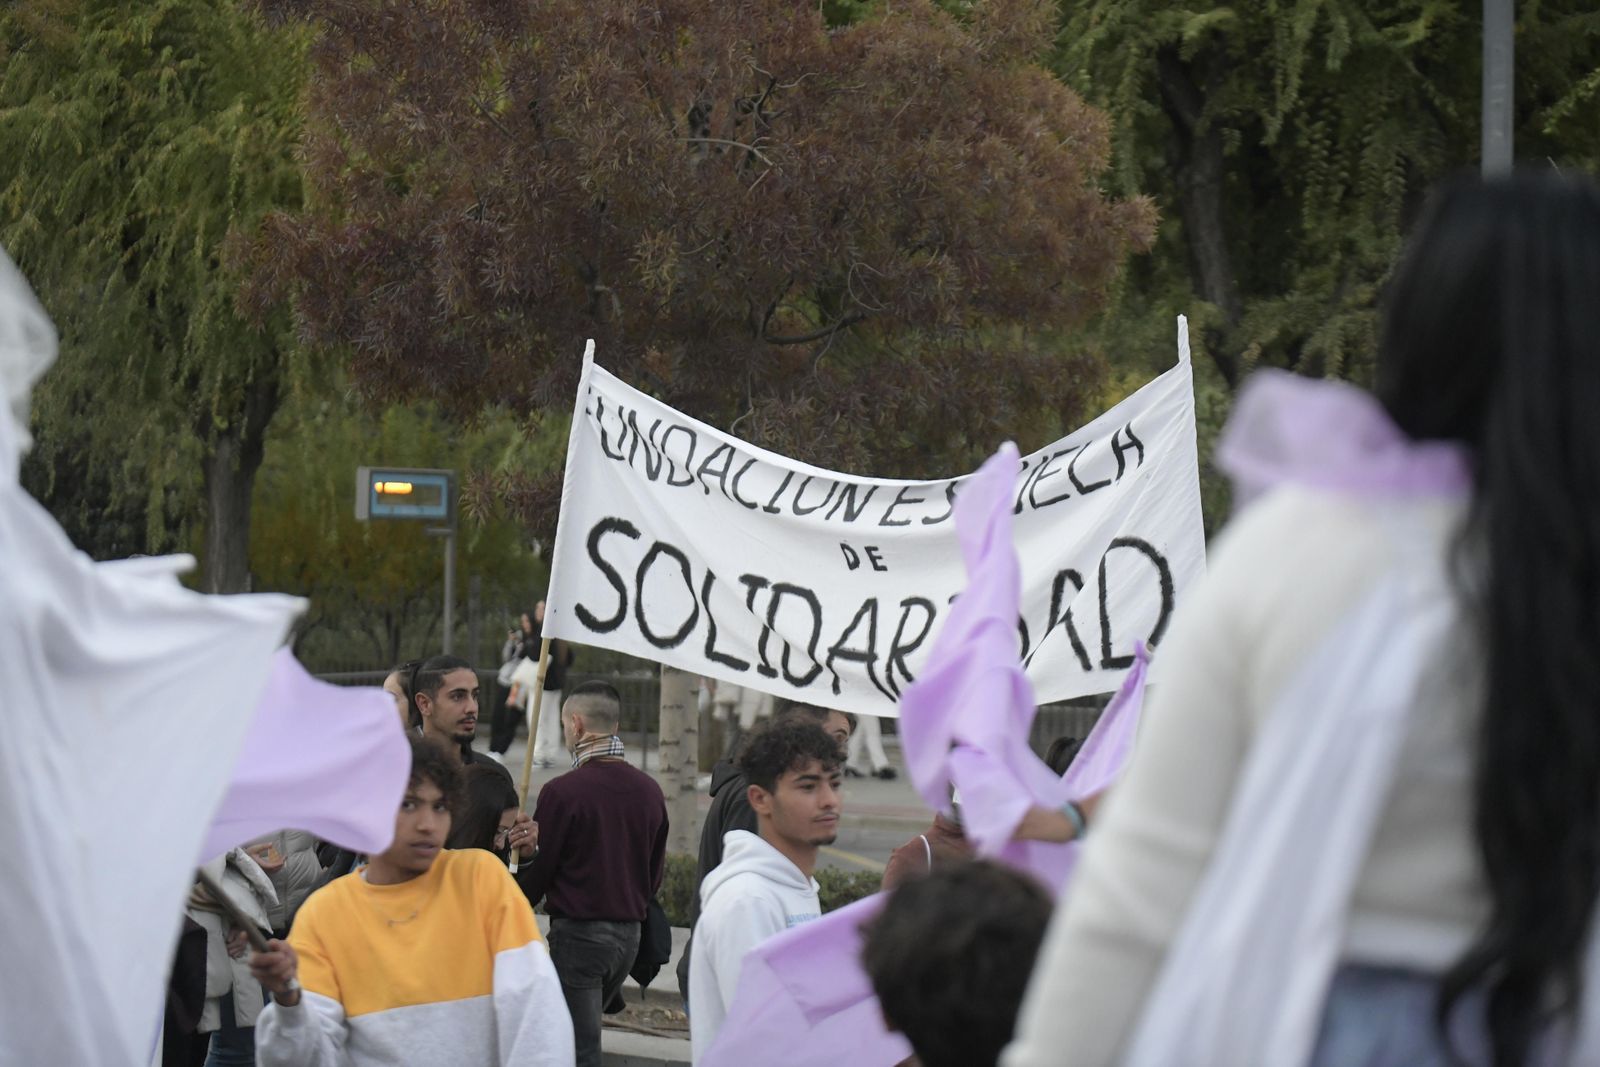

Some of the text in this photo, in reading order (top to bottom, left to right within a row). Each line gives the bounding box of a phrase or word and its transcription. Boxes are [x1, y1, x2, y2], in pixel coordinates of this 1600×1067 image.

[586, 387, 879, 522] UNDACION
[574, 517, 1175, 703] SOLIDARAD
[840, 542, 887, 571] DE
